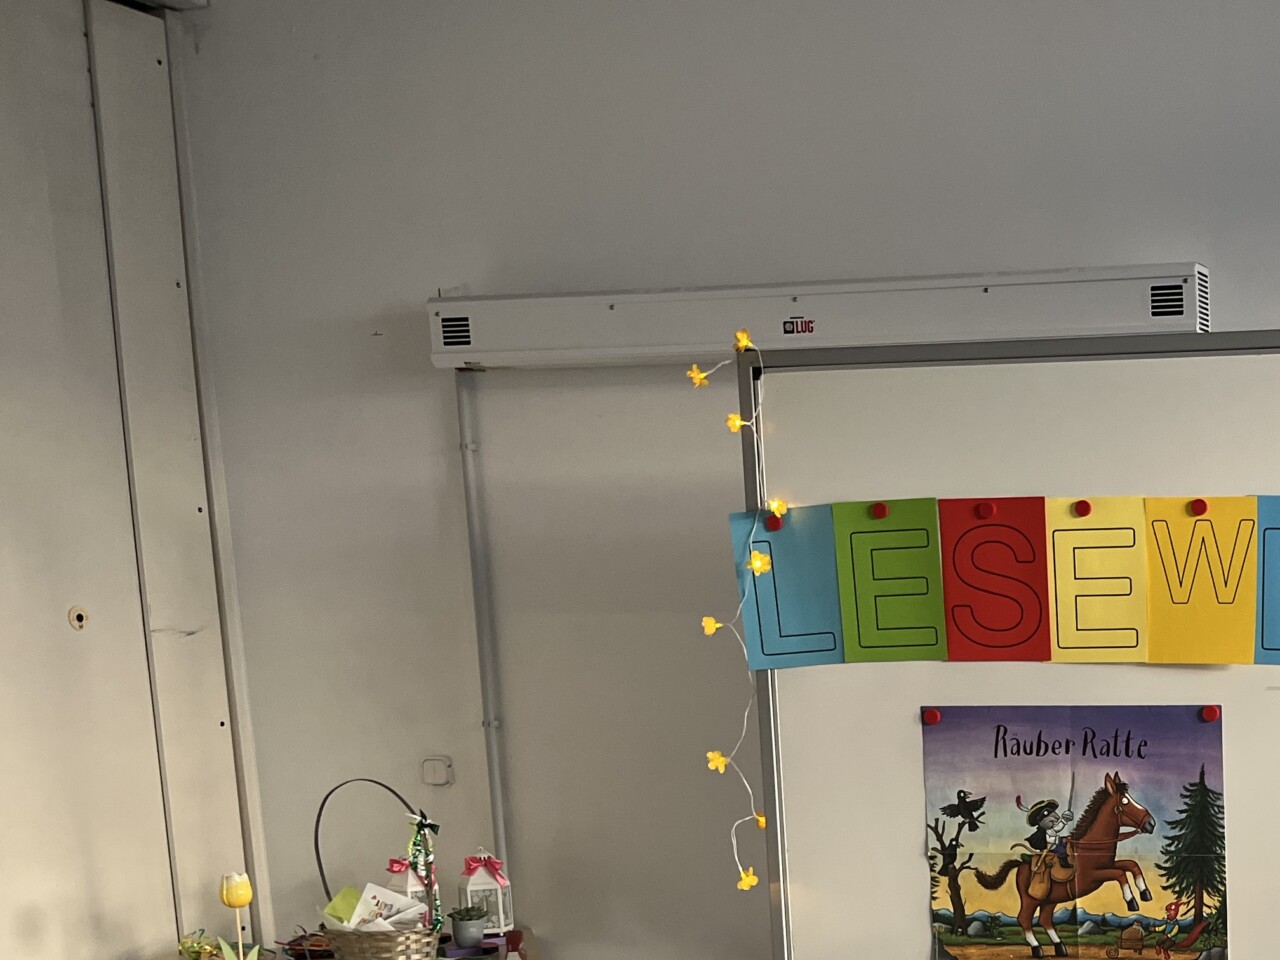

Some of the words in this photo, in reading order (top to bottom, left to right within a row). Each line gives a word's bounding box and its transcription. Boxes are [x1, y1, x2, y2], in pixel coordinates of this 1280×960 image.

[795, 320, 814, 334] LUG
[993, 724, 1076, 759] Räuber
[1082, 727, 1148, 760] Ratte
